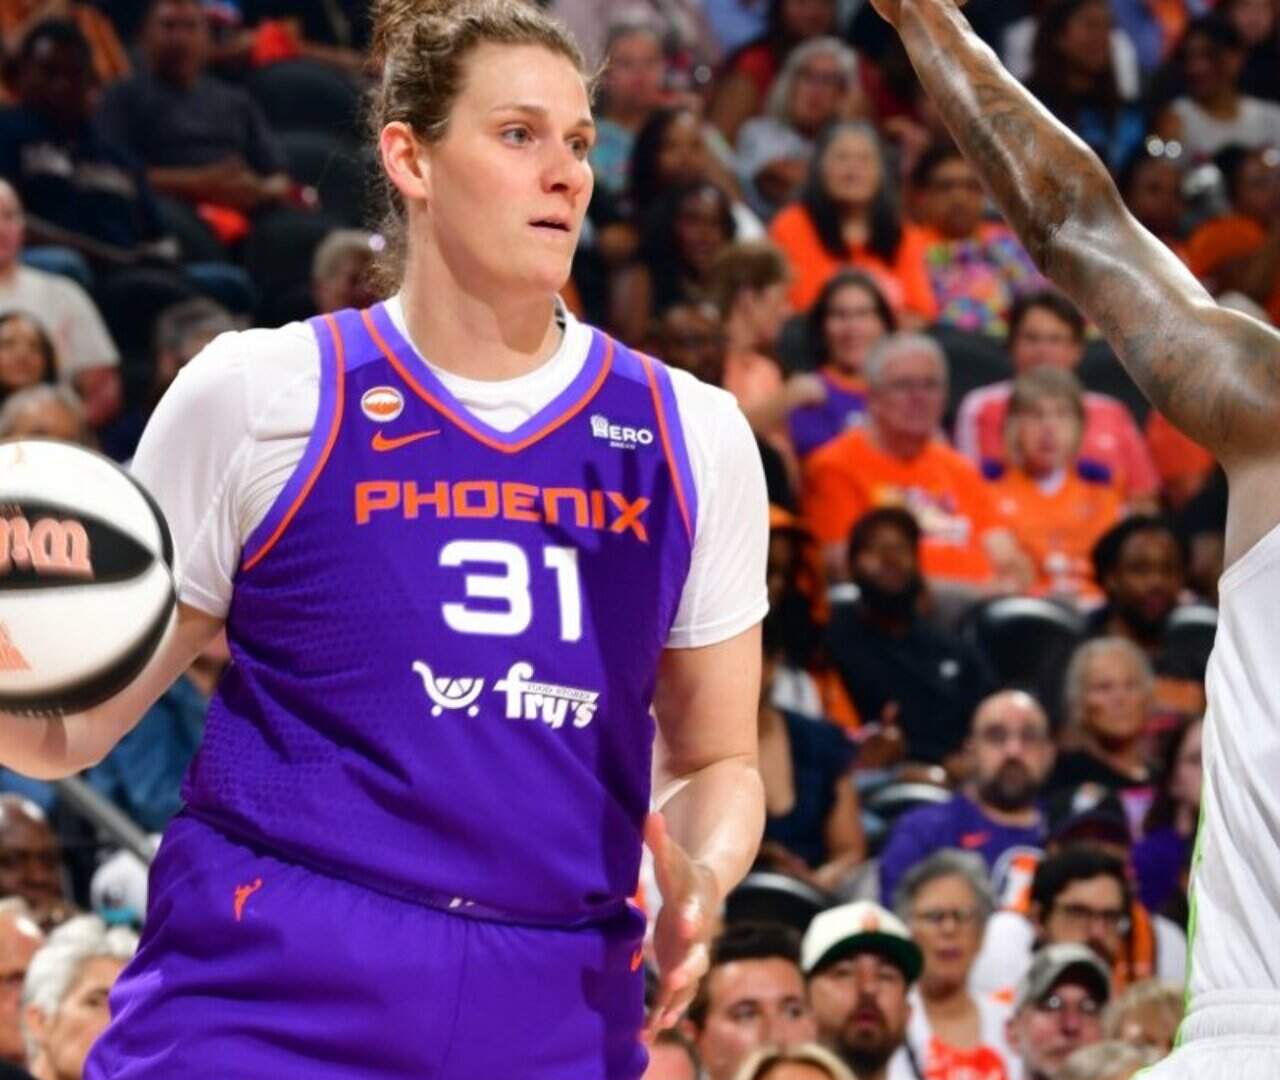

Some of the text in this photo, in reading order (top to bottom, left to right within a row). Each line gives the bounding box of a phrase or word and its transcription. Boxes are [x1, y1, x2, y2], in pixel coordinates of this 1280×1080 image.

[590, 414, 654, 445] HERO
[354, 480, 652, 544] PHOENIX
[438, 538, 585, 643] 31
